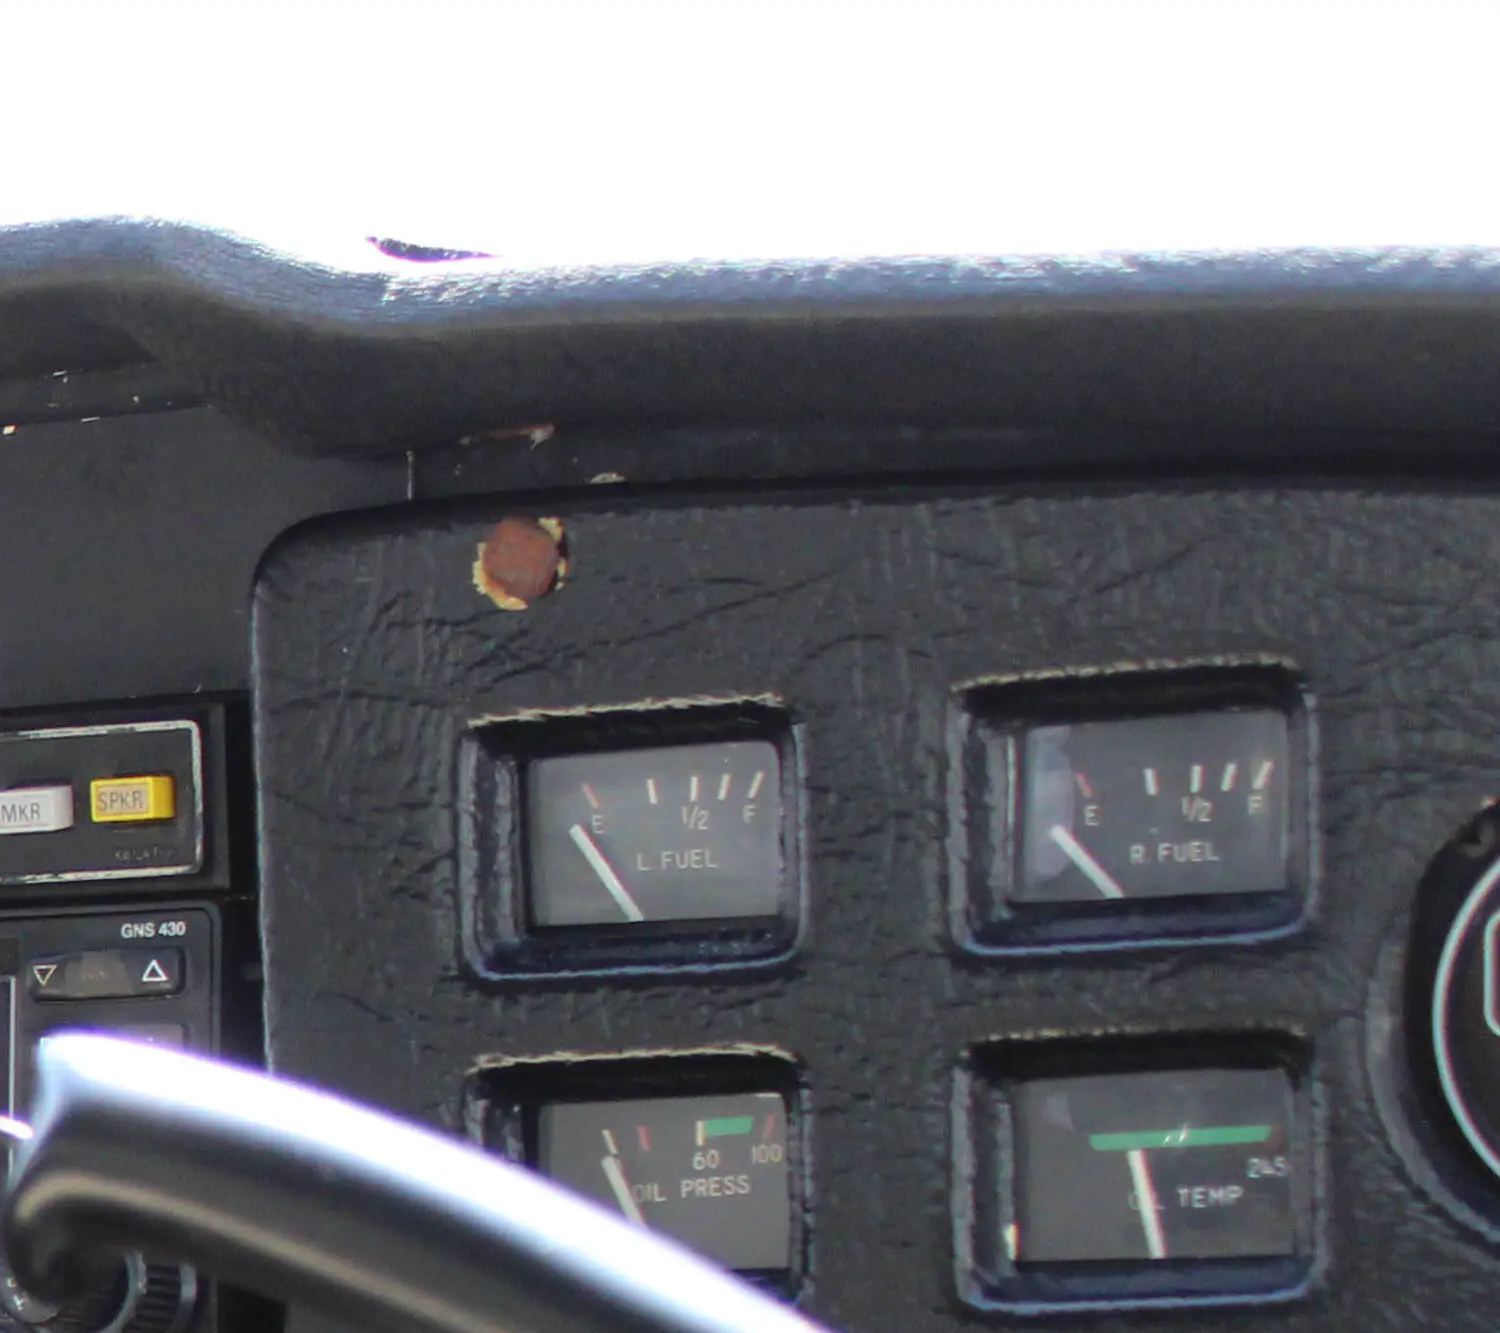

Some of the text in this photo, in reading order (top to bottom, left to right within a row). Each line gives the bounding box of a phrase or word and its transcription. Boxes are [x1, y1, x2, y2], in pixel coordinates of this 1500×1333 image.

[1, 802, 41, 823] MKR
[661, 849, 718, 870] FUEL
[1158, 840, 1221, 864] FUEL
[121, 920, 186, 939] GNS 430
[692, 1149, 720, 1170] 60
[680, 1175, 751, 1199] PRESS
[1176, 1185, 1244, 1209] TEMP
